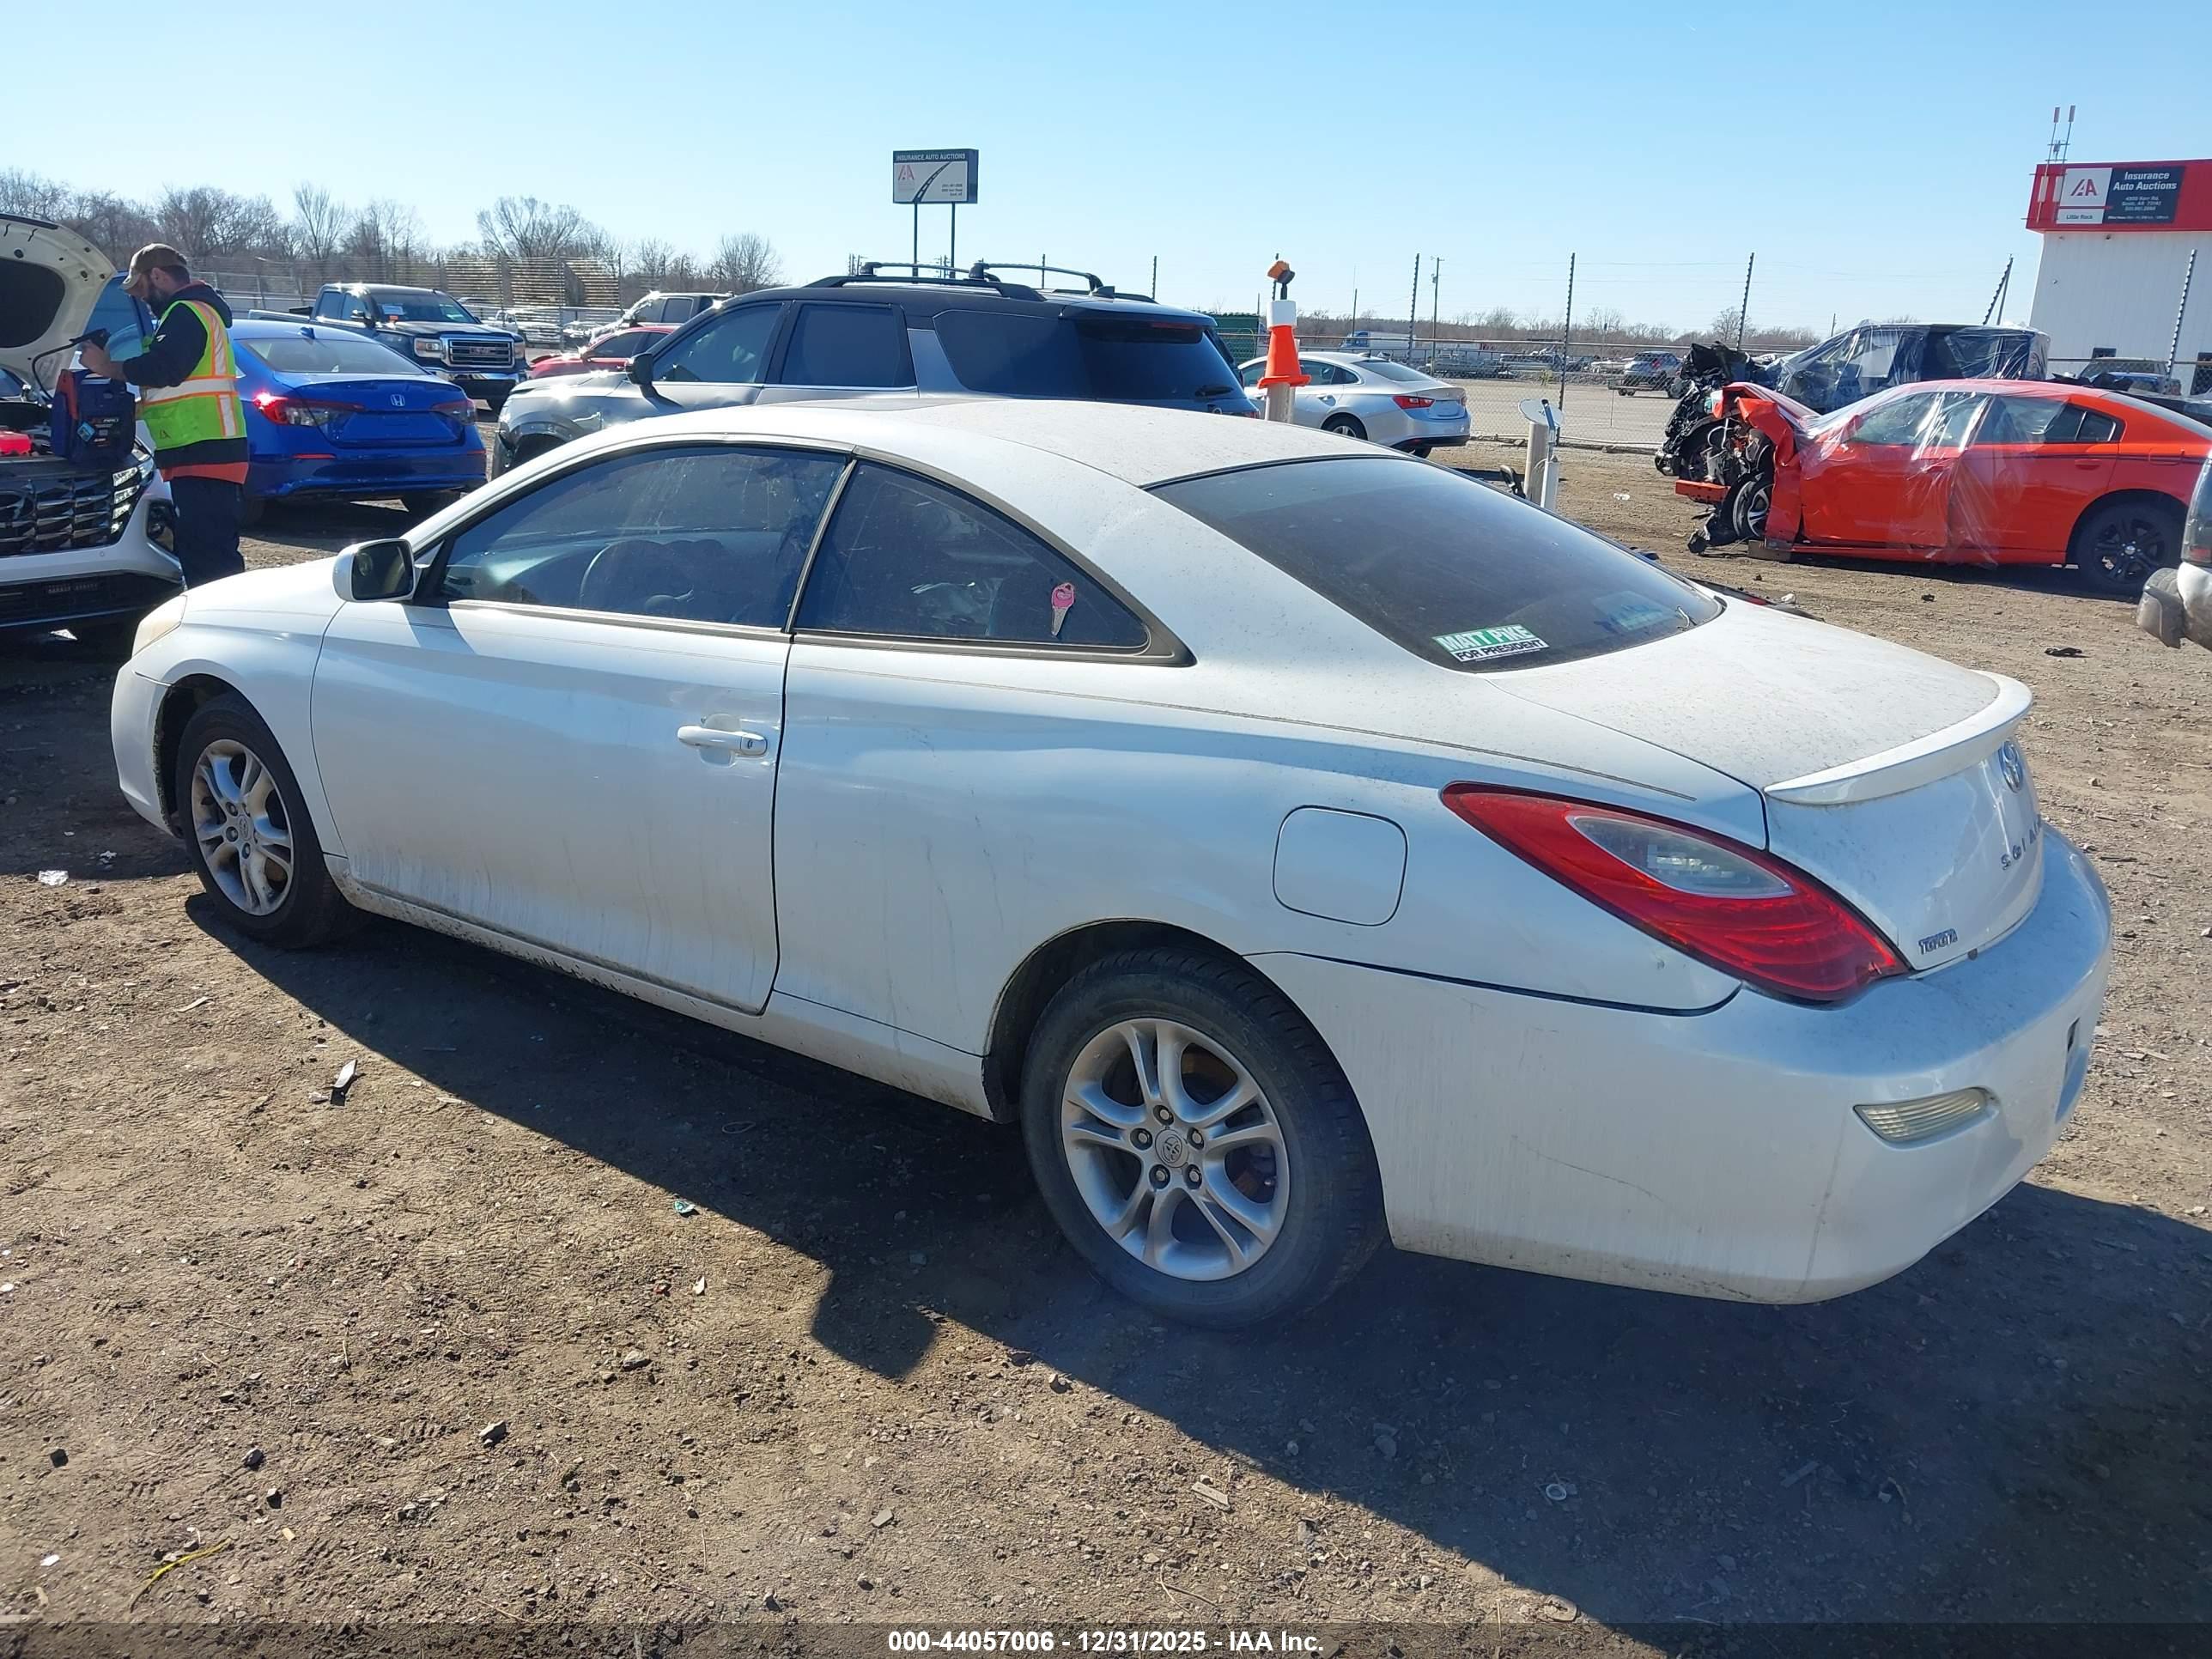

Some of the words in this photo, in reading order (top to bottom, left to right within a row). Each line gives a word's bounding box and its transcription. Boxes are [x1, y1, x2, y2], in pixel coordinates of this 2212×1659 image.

[2112, 181, 2135, 191] Auto
[2136, 181, 2178, 191] Auctions
[2124, 171, 2171, 180] Insurance
[1437, 630, 1491, 652] MATT
[1455, 648, 1484, 661] FOR
[1483, 639, 1545, 657] PRESIDENT
[1918, 928, 1959, 955] TOYOTA
